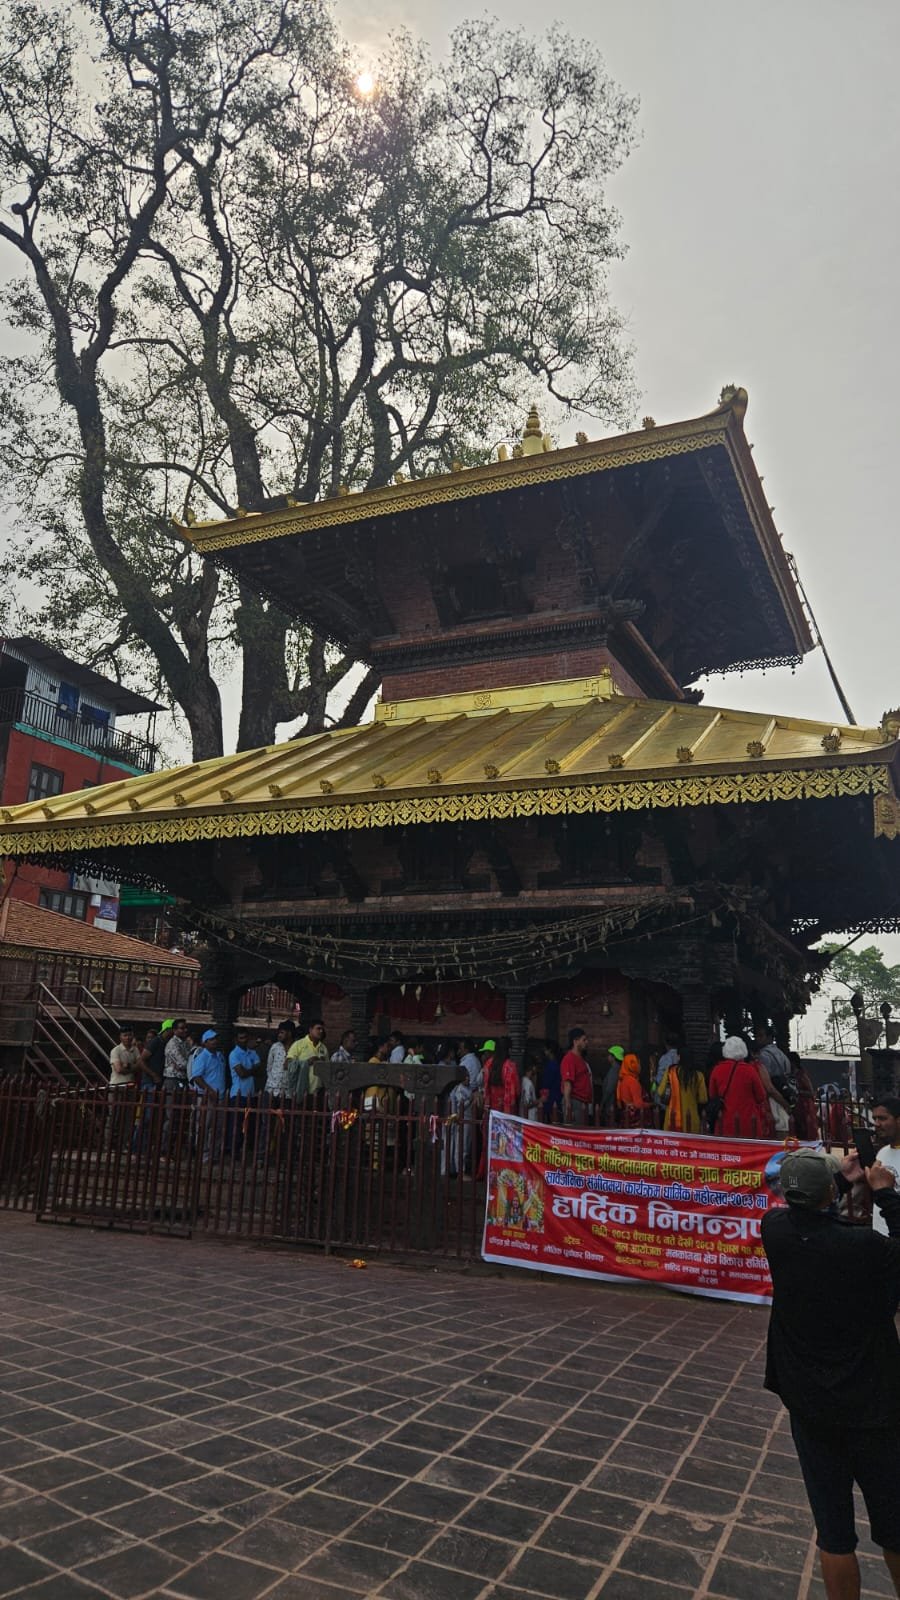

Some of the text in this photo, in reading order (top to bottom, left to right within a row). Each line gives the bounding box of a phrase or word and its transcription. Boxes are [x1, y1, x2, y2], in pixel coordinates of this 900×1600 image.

[525, 1143, 541, 1163] देवी
[544, 1145, 572, 1167] महिमा
[698, 1166, 720, 1184] ज्ञान
[723, 1168, 762, 1188] महायज्ञ
[545, 1169, 585, 1188] सार्वजनिक
[623, 1178, 661, 1198] कार्यक्रम
[663, 1181, 692, 1201] धार्मिक
[755, 1193, 768, 1209] मा
[551, 1191, 639, 1225] हार्दिक
[719, 1254, 743, 1267] विकास
